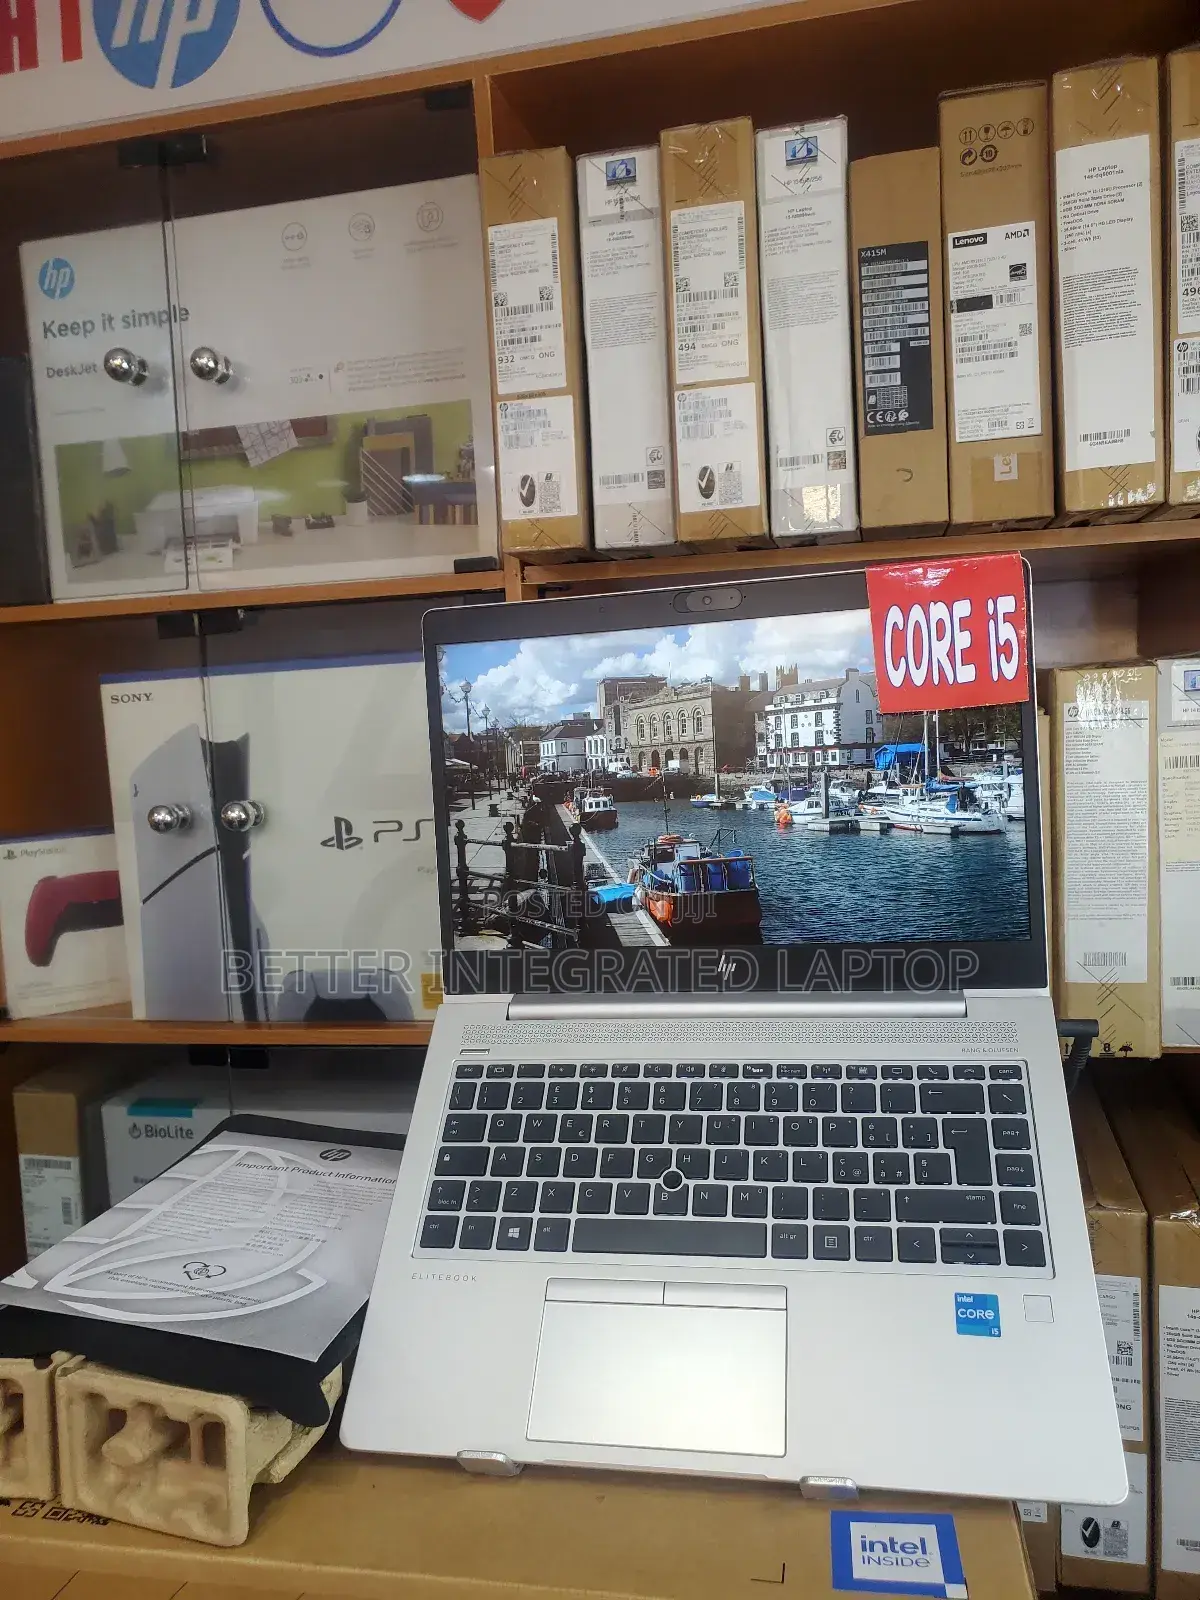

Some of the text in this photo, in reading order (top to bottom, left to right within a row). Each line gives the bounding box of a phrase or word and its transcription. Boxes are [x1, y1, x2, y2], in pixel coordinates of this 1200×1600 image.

[1004, 230, 1022, 241] AMD
[954, 236, 985, 247] Lenovo
[860, 248, 887, 258] X415M
[41, 258, 73, 300] hp
[42, 304, 190, 340] Keep it simple
[678, 342, 696, 352] 494
[498, 351, 556, 364] 932 ONG
[46, 363, 98, 379] DeskJet
[884, 594, 1020, 688] CORE i5
[110, 692, 153, 704] SONY
[496, 1119, 505, 1128] Q
[532, 1119, 542, 1128] W
[602, 1120, 610, 1128] R
[638, 1120, 645, 1128] T
[676, 1120, 684, 1128] Y
[714, 1120, 722, 1129] U
[829, 1122, 837, 1130] P
[144, 1124, 194, 1140] BioLite
[320, 1148, 352, 1162] hp
[500, 1152, 508, 1162] A
[535, 1153, 542, 1162] S
[571, 1154, 578, 1162] D
[608, 1154, 614, 1162] F
[646, 1154, 654, 1162] G
[683, 1154, 690, 1162] H
[760, 1156, 768, 1166] K
[236, 1161, 289, 1173] Important
[290, 1166, 334, 1178] Product
[510, 1188, 518, 1196] Z
[547, 1189, 554, 1197] X
[586, 1189, 592, 1198] C
[624, 1190, 631, 1198] V
[662, 1192, 668, 1201] B
[700, 1192, 708, 1200] N
[740, 1192, 749, 1200] M
[966, 1194, 986, 1202] stamp
[412, 1272, 478, 1282] ELITEBOOK
[956, 1294, 974, 1303] intel
[957, 1308, 994, 1320] CORE
[990, 1328, 999, 1336] i5
[860, 1535, 927, 1556] intel
[862, 1554, 930, 1568] INSIDE
